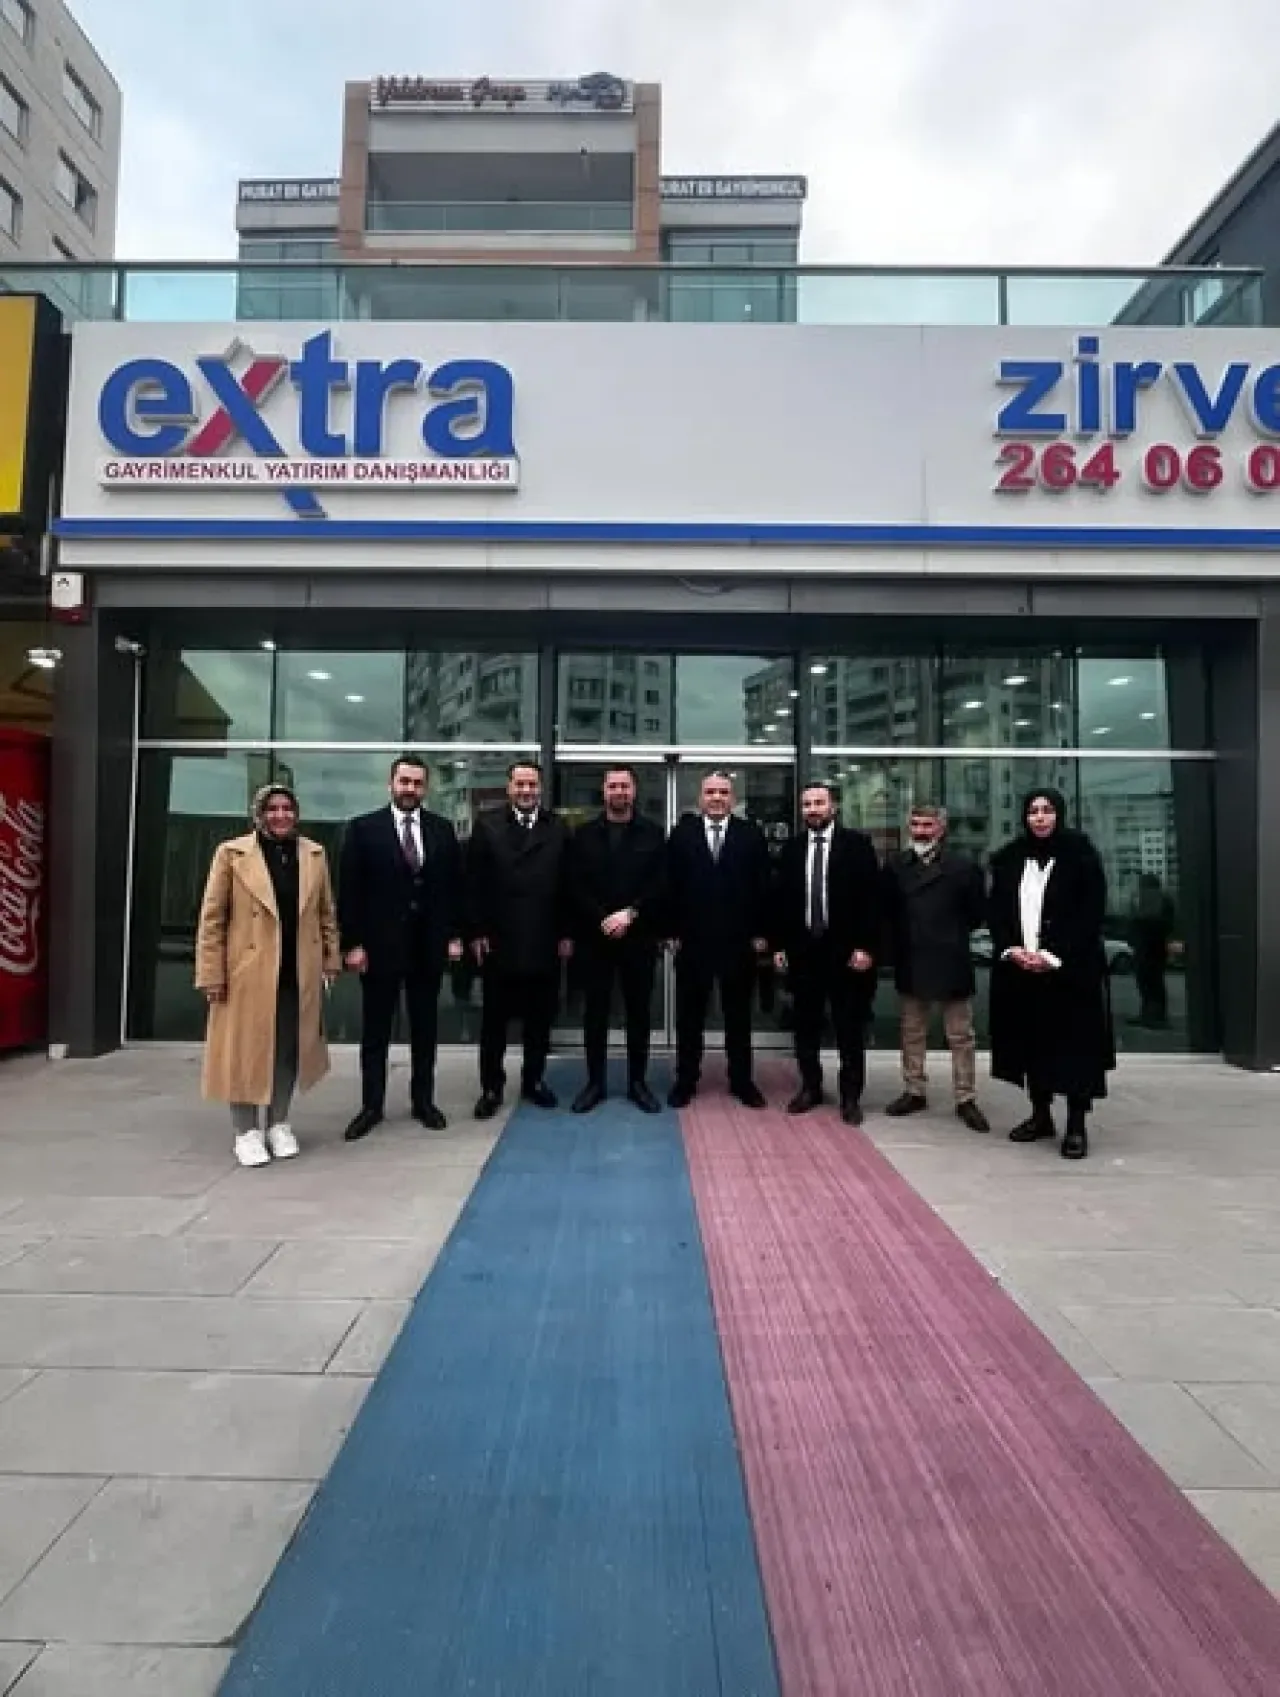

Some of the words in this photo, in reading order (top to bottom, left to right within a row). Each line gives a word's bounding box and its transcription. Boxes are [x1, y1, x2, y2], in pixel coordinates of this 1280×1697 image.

[99, 331, 516, 457] extra
[105, 458, 259, 480] GAYRİMENKUL
[264, 460, 347, 480] YATIRIM
[353, 460, 510, 483] DANIŞMANLIĞI
[998, 442, 1119, 489] 264
[1143, 443, 1223, 490] 06
